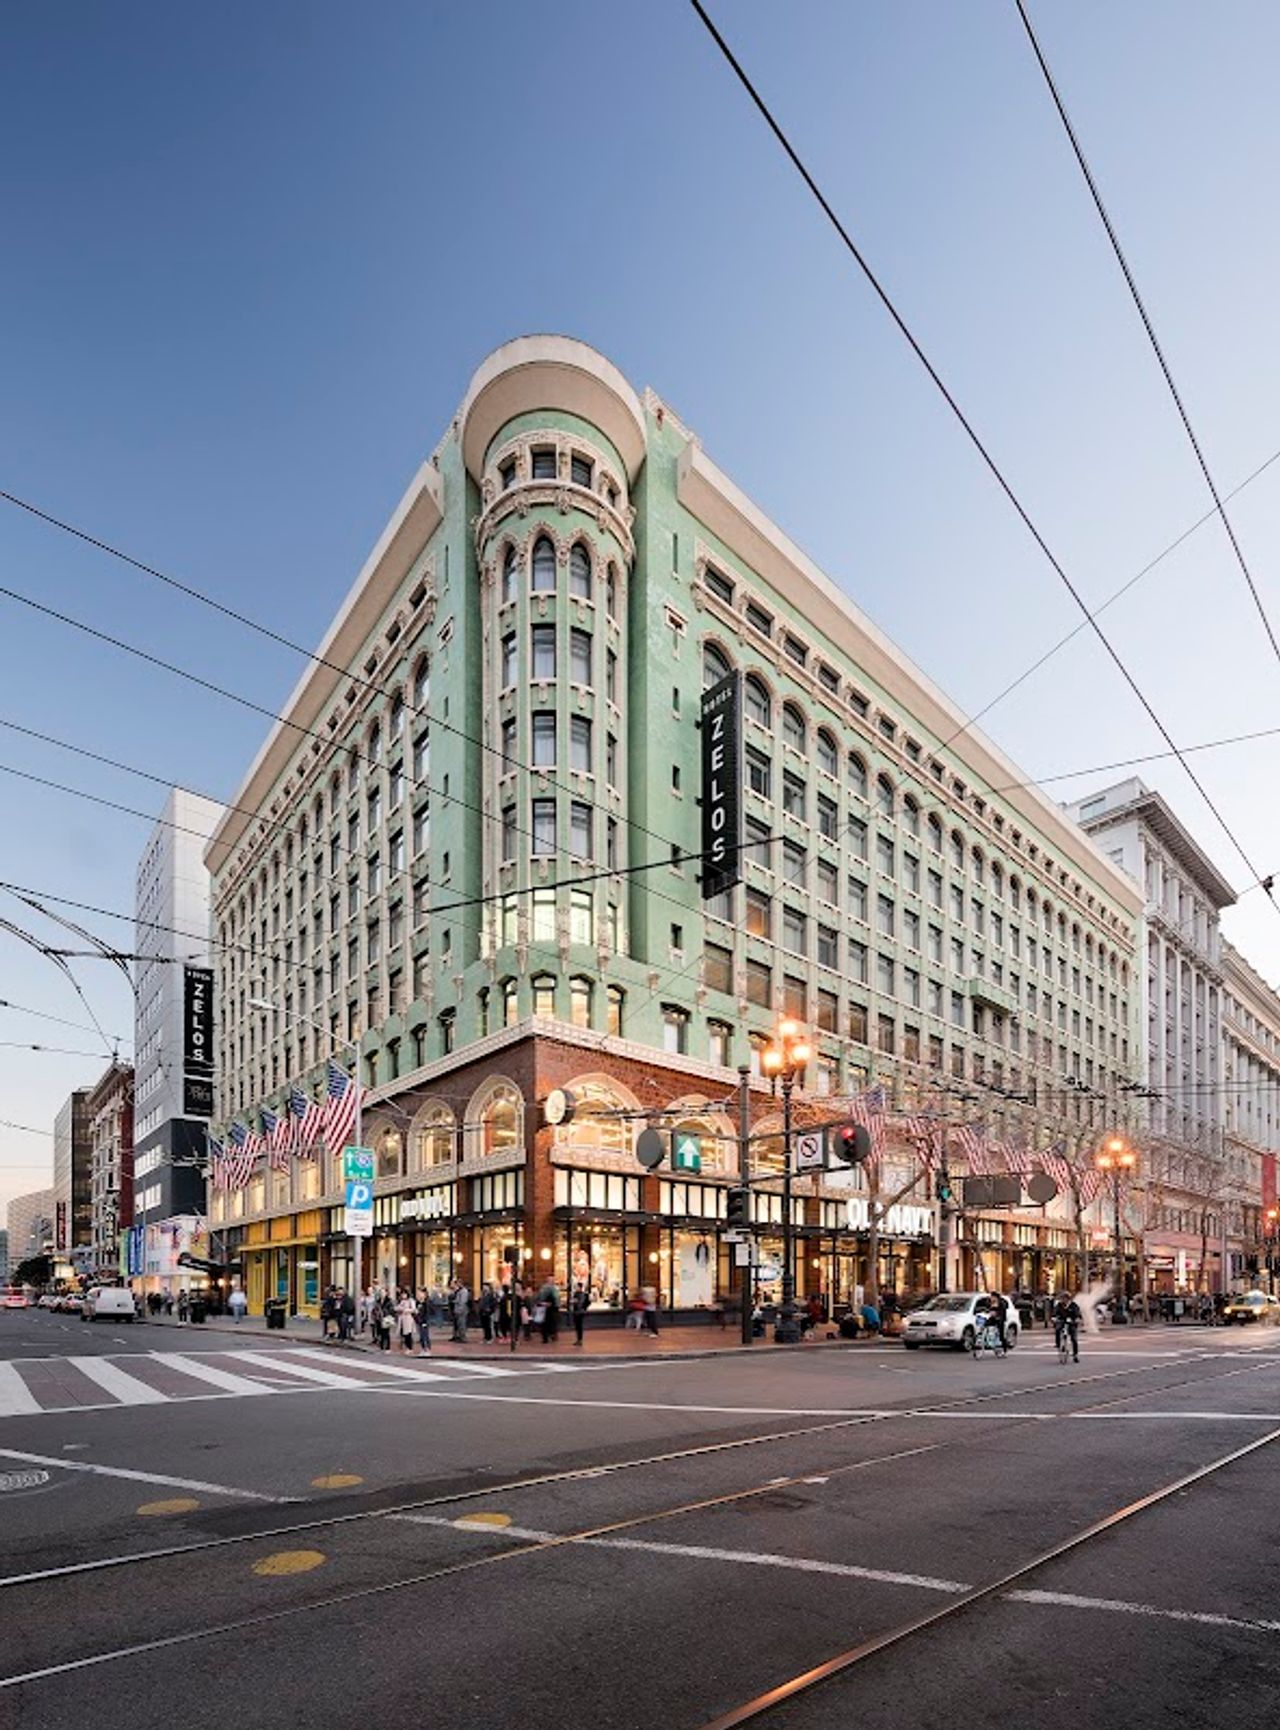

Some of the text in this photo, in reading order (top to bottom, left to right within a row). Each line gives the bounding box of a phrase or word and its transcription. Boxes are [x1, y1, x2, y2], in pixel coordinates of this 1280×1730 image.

[711, 713, 725, 862] ZELOS
[193, 982, 205, 1061] ZELOS
[886, 1203, 932, 1235] NAVY
